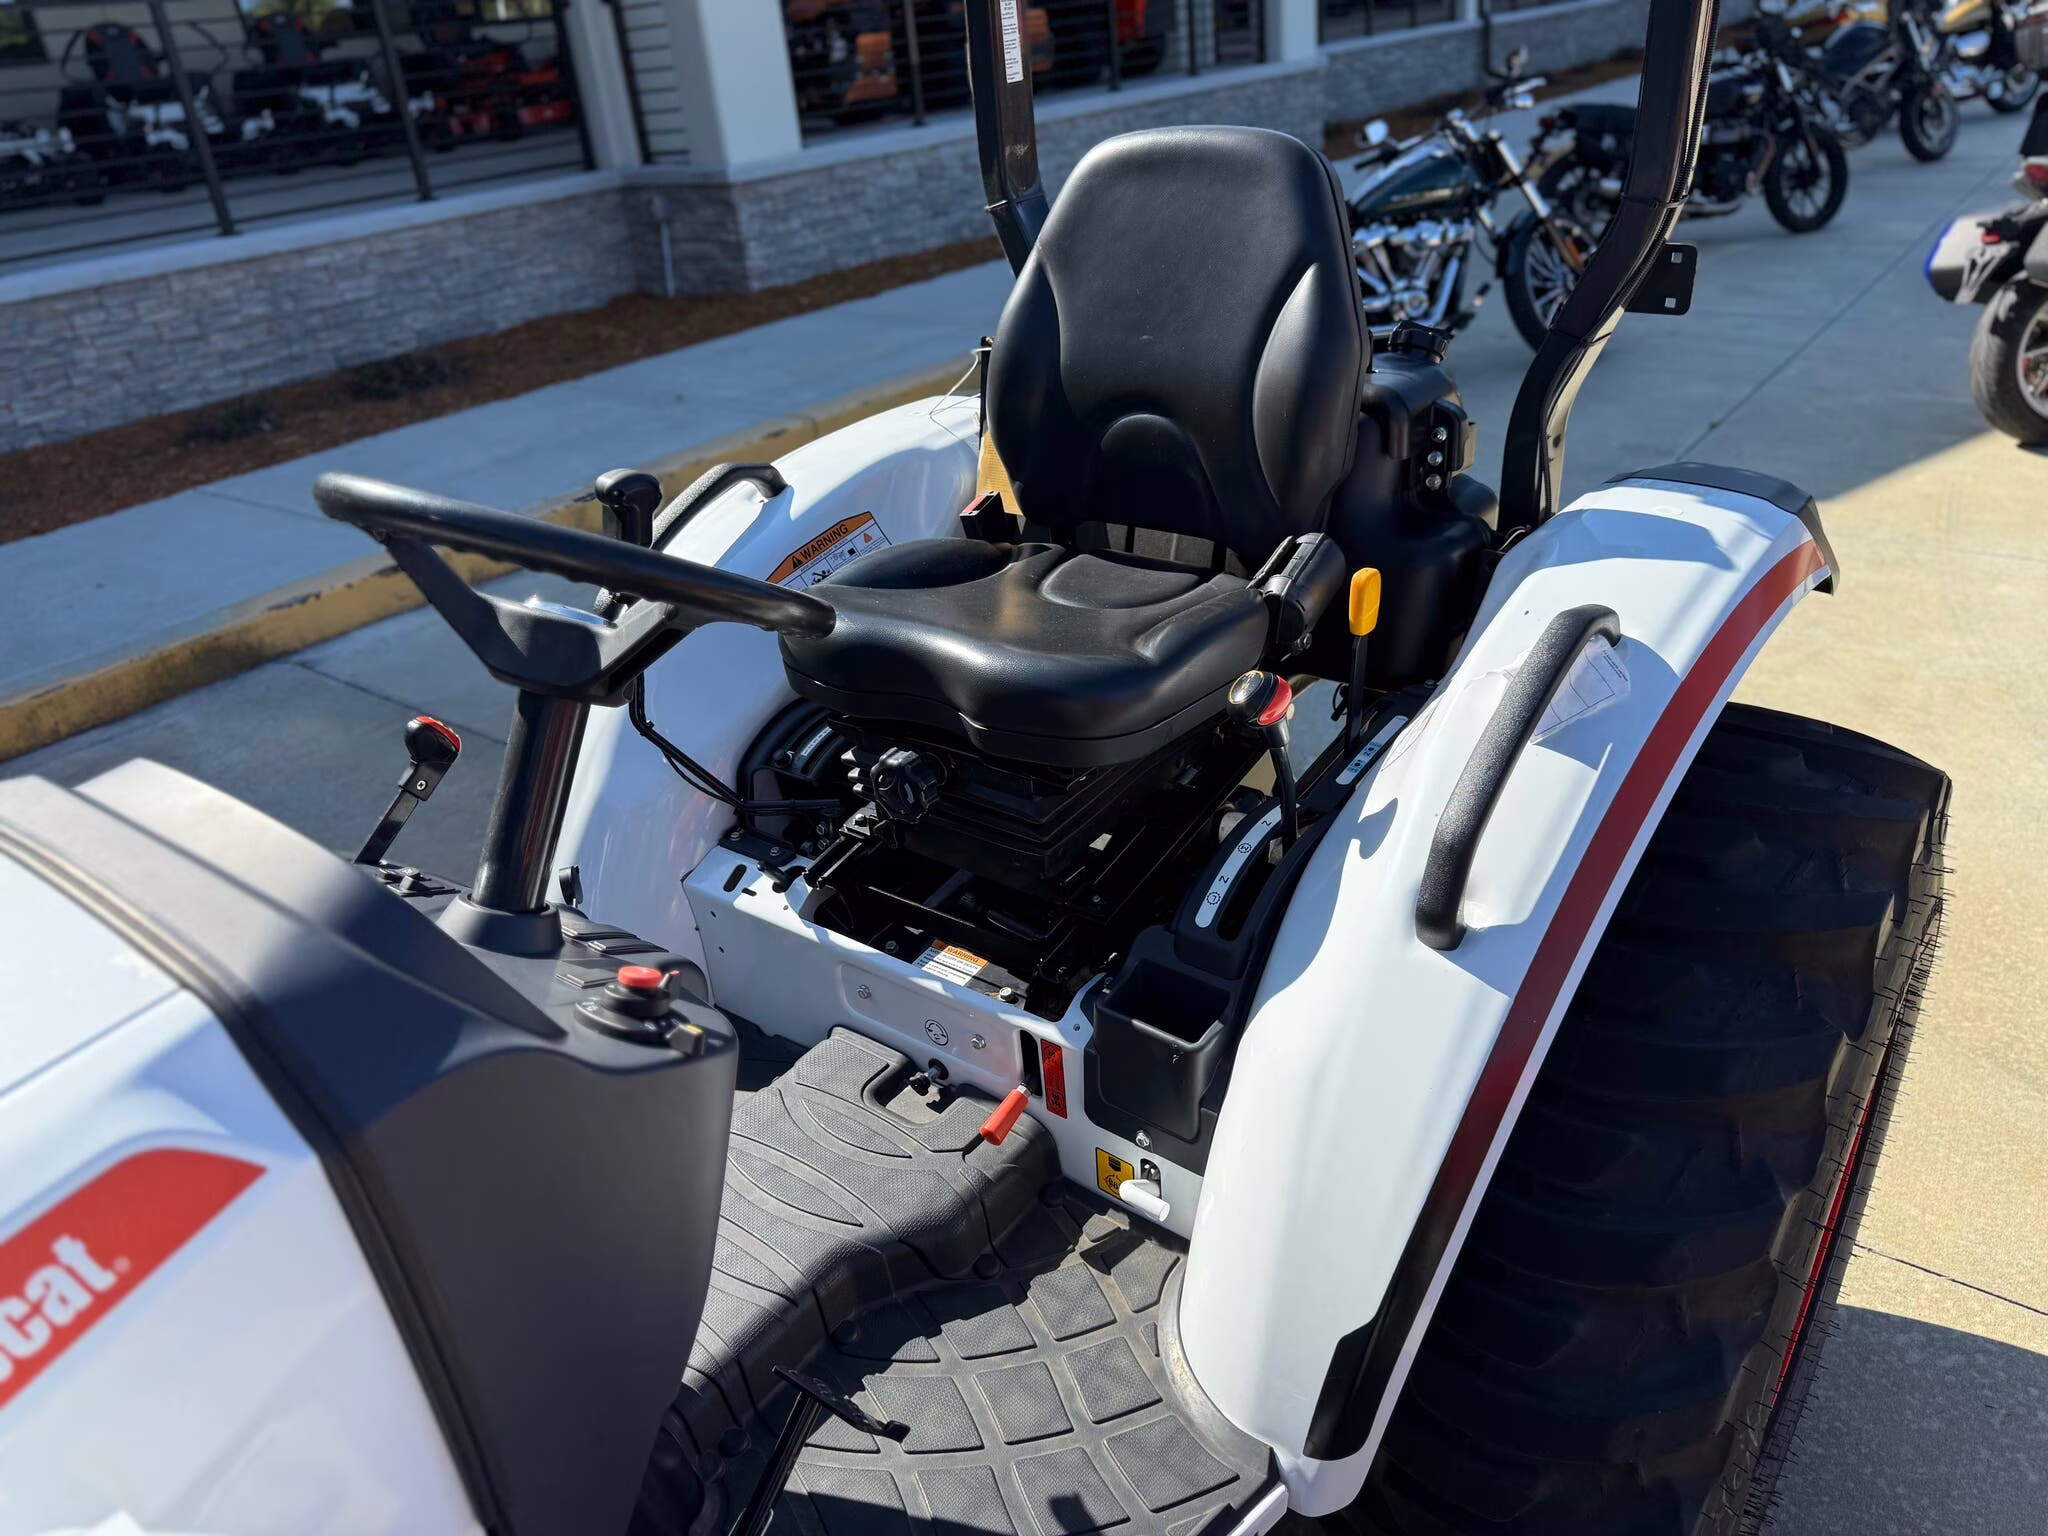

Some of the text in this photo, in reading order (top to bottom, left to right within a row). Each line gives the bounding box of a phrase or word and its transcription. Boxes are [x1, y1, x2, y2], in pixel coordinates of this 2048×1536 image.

[800, 524, 848, 560] WARNING
[947, 947, 979, 963] WARNING
[0, 1234, 118, 1385] cat
